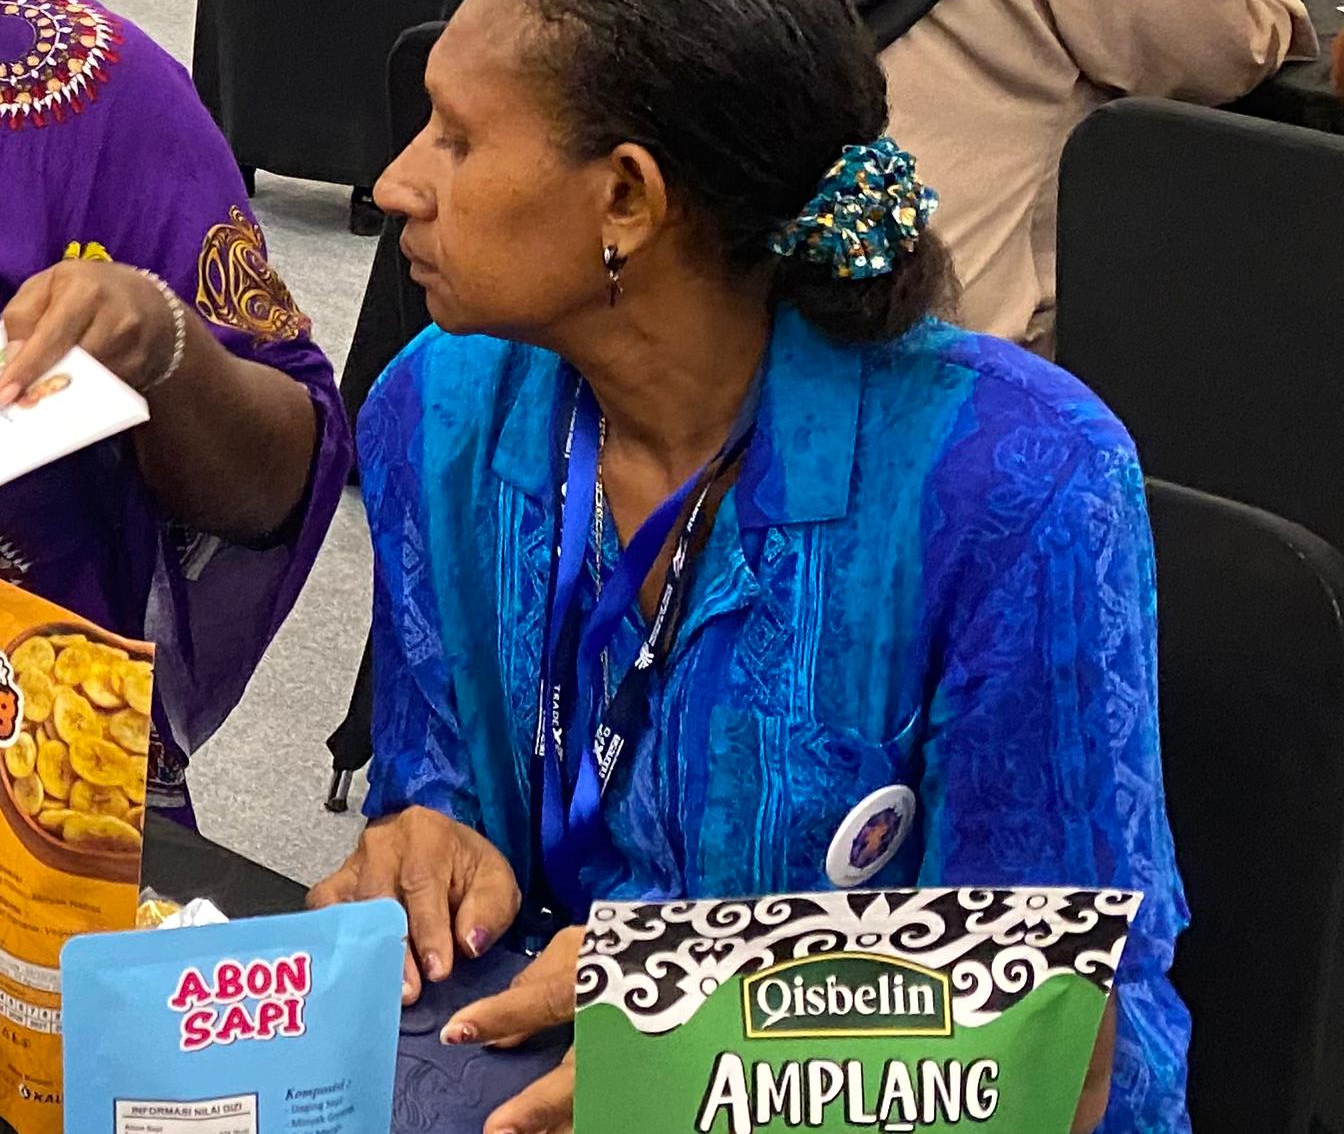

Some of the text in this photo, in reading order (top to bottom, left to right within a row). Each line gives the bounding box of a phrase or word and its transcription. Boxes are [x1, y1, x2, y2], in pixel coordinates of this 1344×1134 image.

[171, 954, 309, 1008] ABON
[757, 973, 936, 1029] Qisbelin
[182, 999, 303, 1048] SAPI
[131, 1102, 243, 1116] INFORMASI NILAI GIZI
[699, 1051, 1000, 1134] AMPLANG
